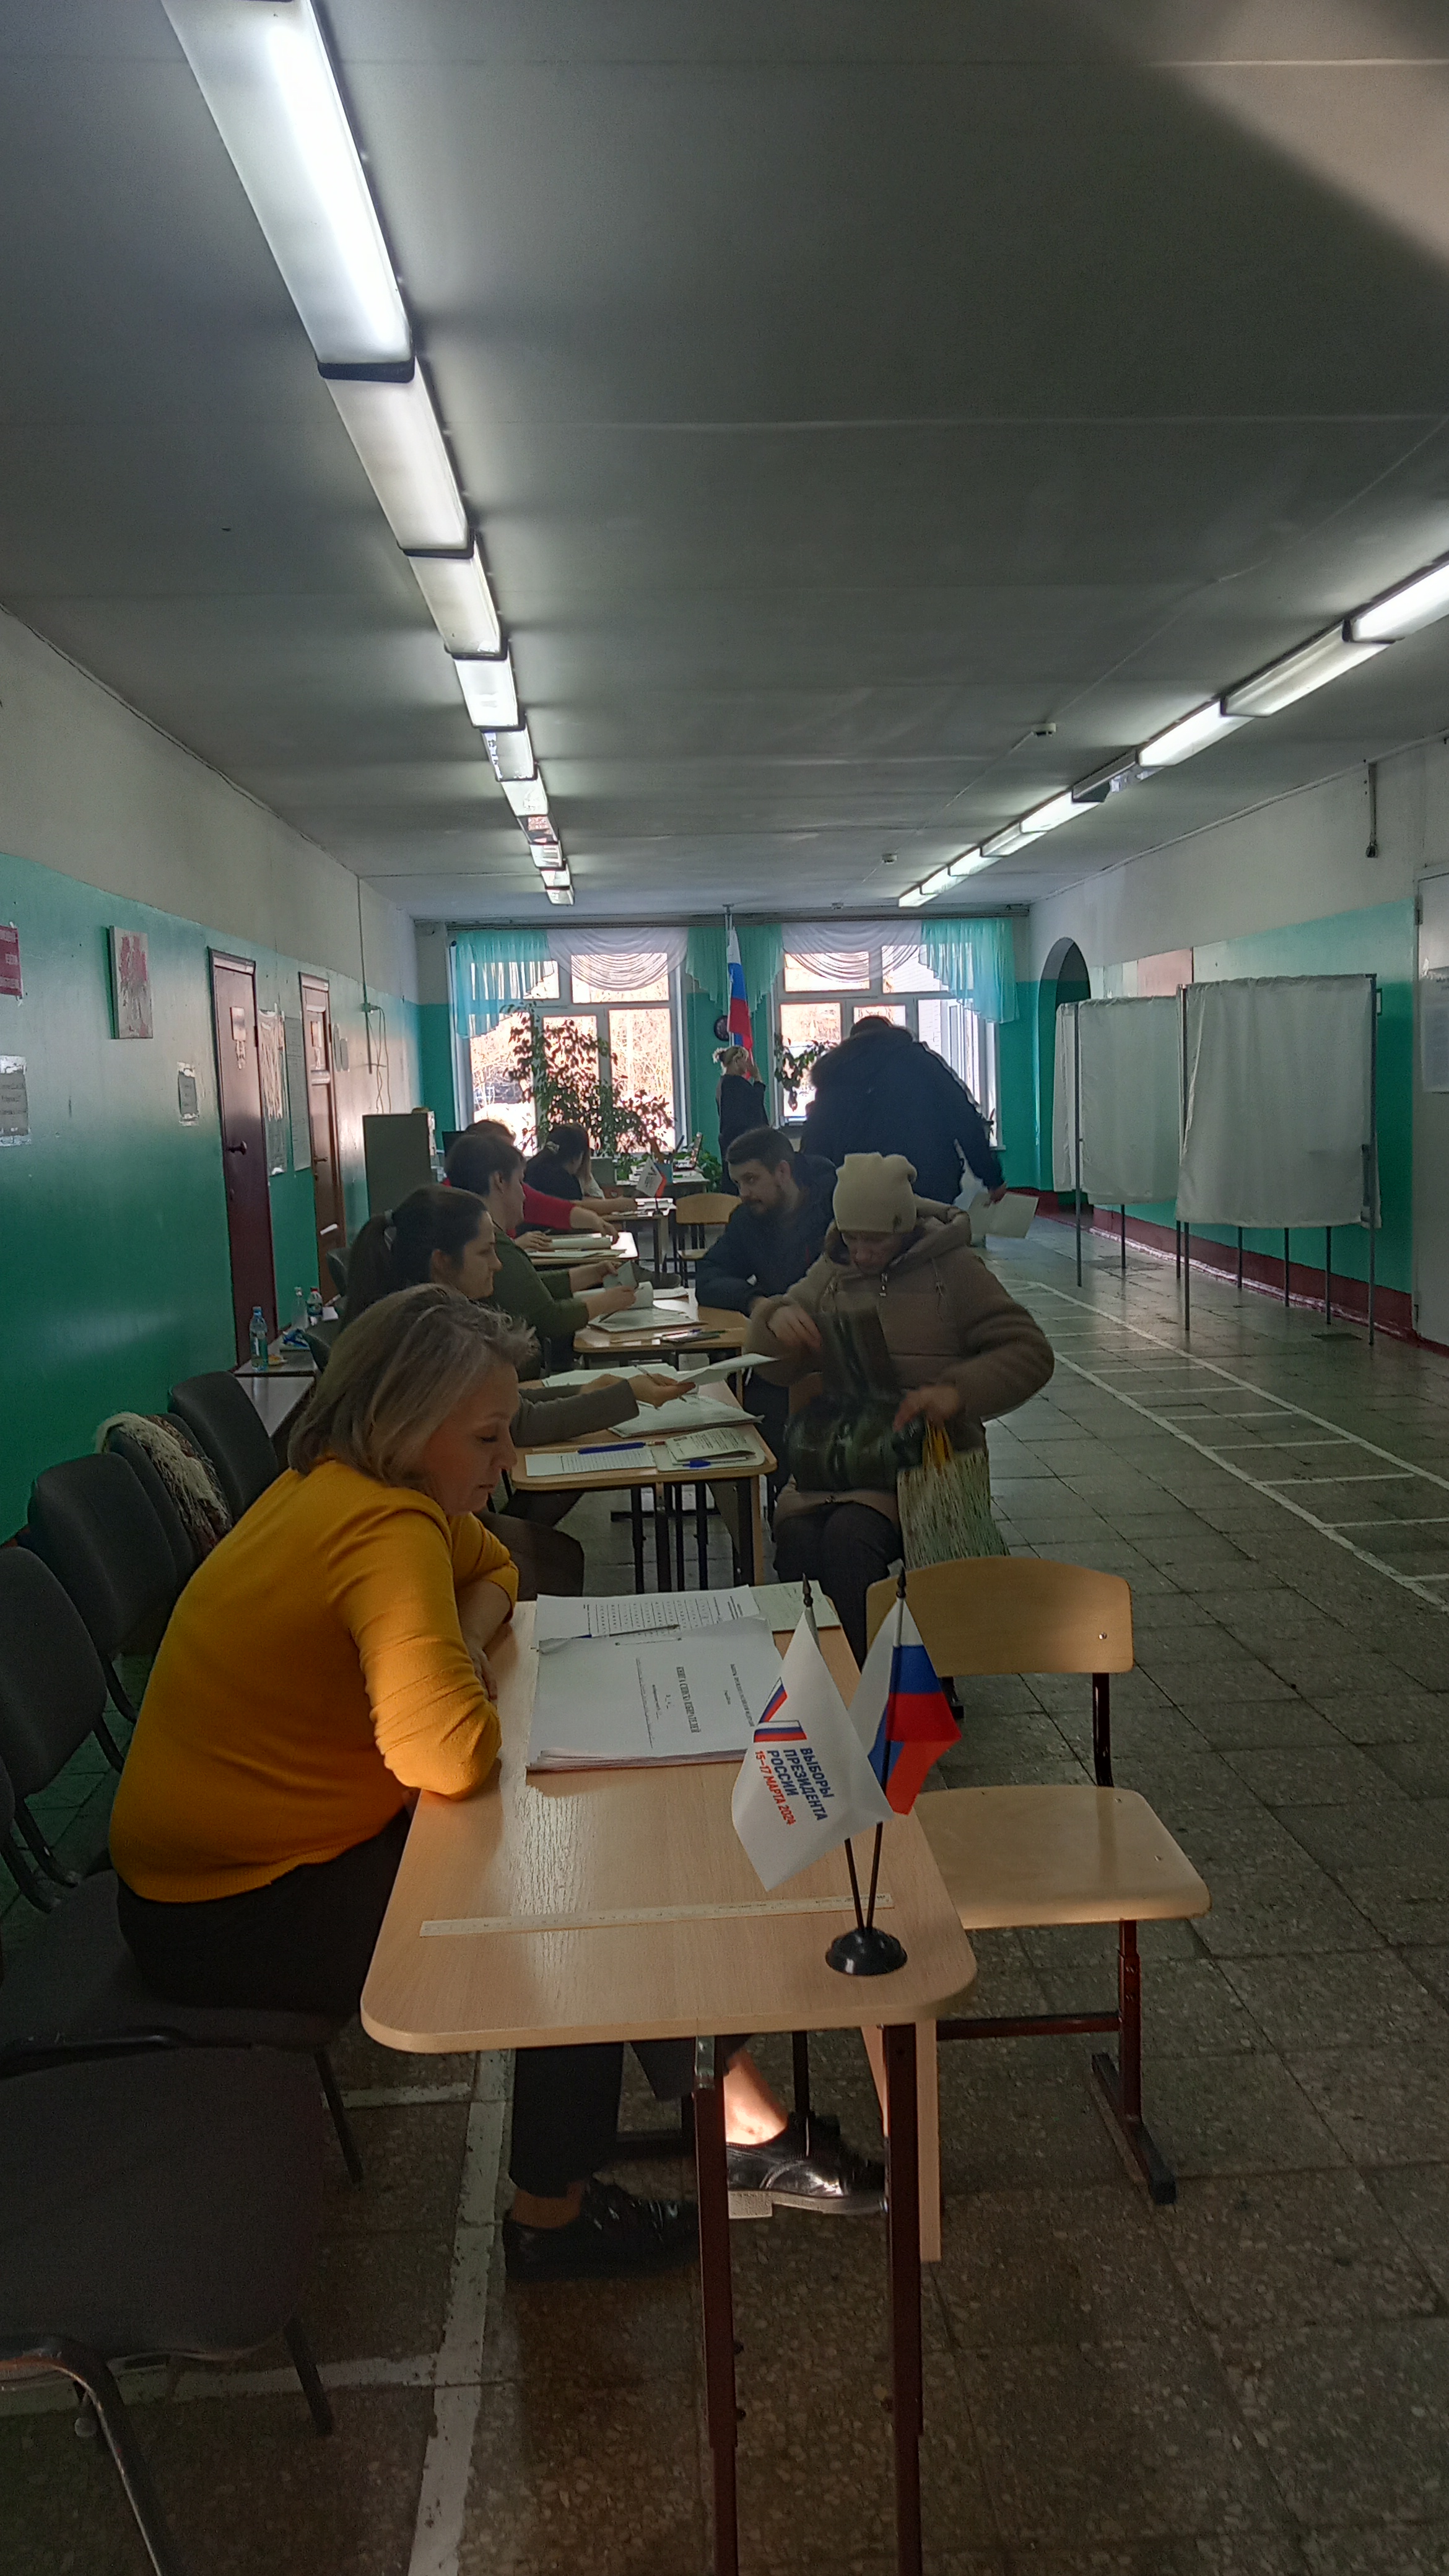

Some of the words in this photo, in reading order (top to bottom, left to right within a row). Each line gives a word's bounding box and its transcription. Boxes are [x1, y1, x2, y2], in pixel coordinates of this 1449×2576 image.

[767, 1750, 799, 1796] РОССИИ
[783, 1749, 828, 1821] ПРЕЗИДЕНТА
[800, 1747, 834, 1798] ВЫБОРЫ
[764, 1776, 786, 1804] МАРТА
[778, 1805, 796, 1825] 2024
